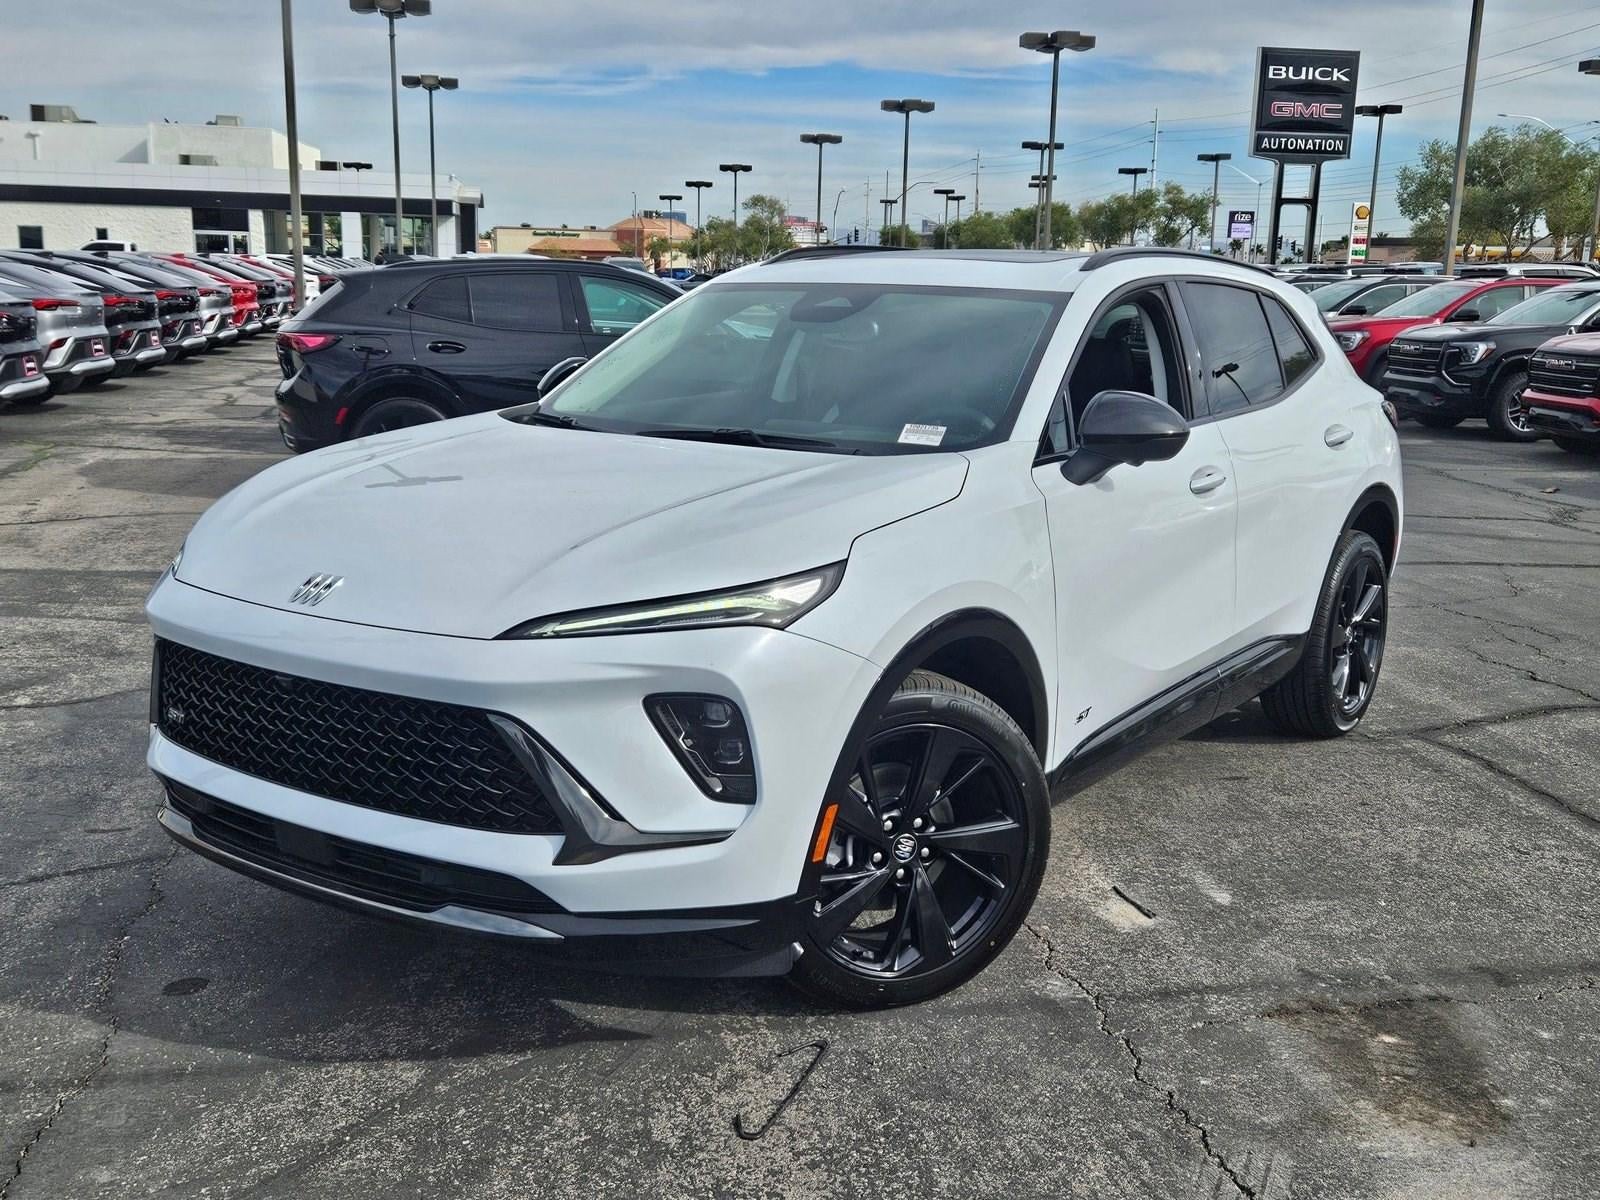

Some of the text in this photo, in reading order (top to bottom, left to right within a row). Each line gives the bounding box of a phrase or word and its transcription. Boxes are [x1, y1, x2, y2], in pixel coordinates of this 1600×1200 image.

[1268, 65, 1351, 82] BUICK
[1270, 101, 1343, 119] GMC
[1261, 137, 1344, 151] AUTONATION
[1234, 211, 1252, 221] rize
